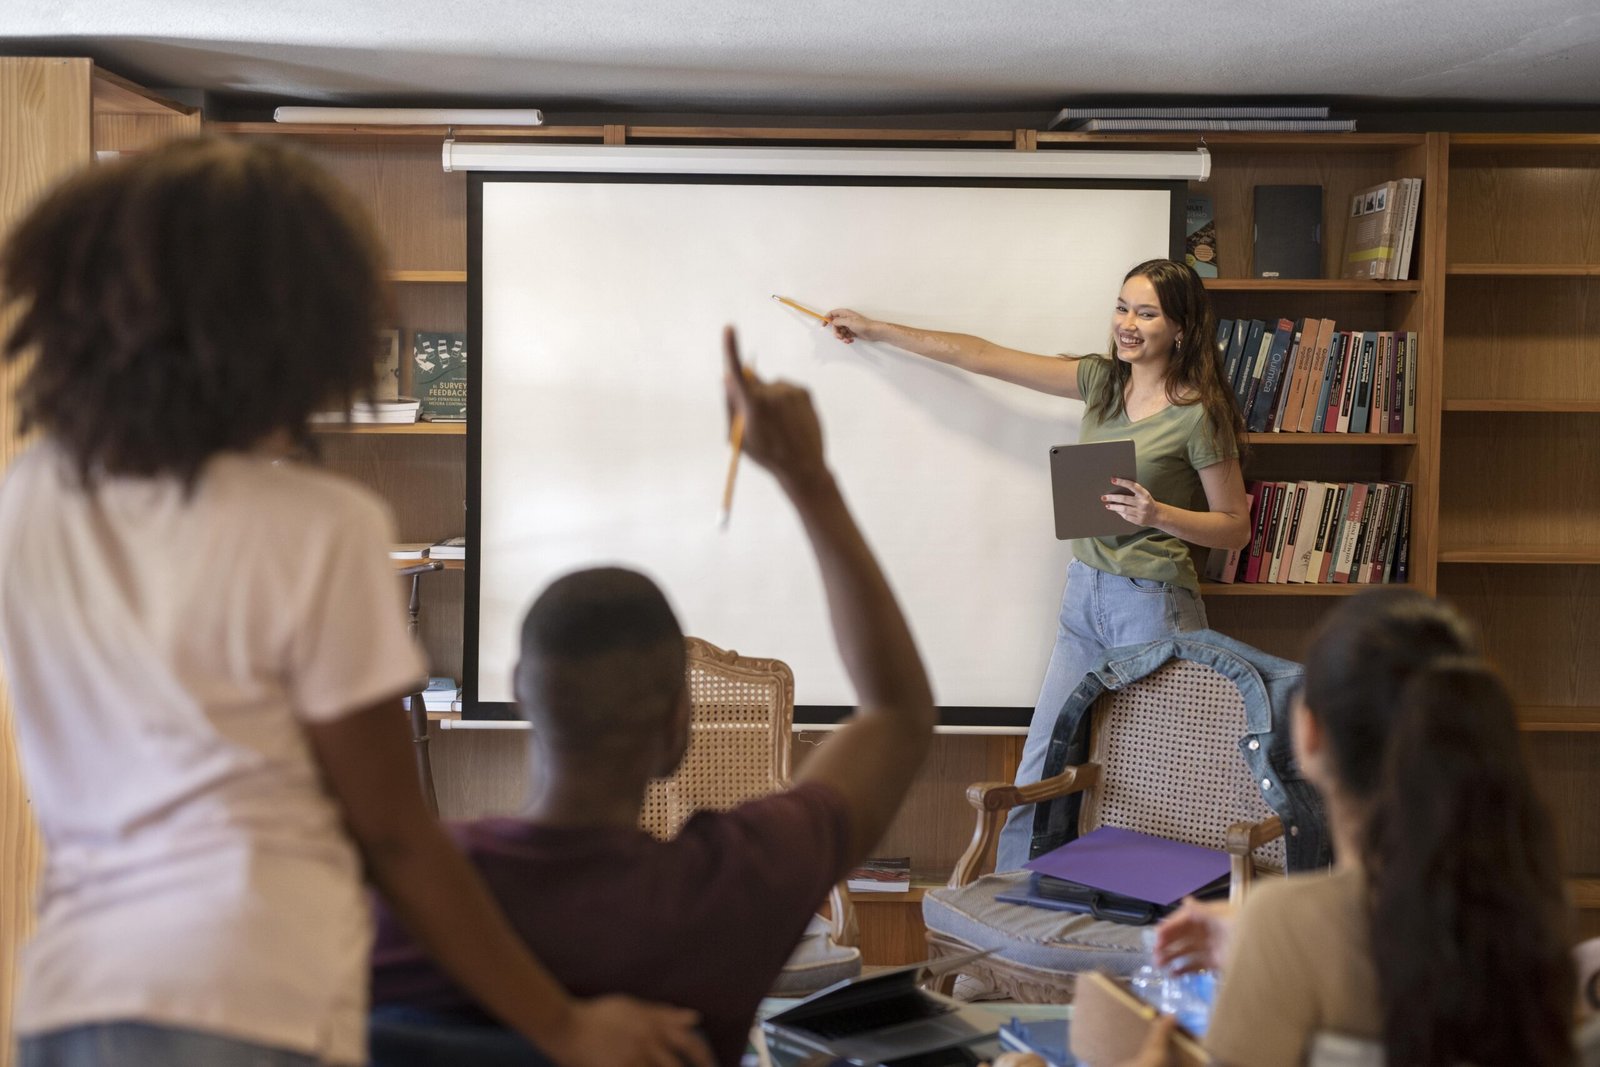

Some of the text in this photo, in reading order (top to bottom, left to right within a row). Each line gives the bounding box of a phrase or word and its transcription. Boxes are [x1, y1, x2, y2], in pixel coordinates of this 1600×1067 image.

[1304, 347, 1312, 370] Química
[1319, 348, 1328, 371] Química
[1263, 353, 1281, 393] Química
[1345, 537, 1354, 563] QUÍMICA
